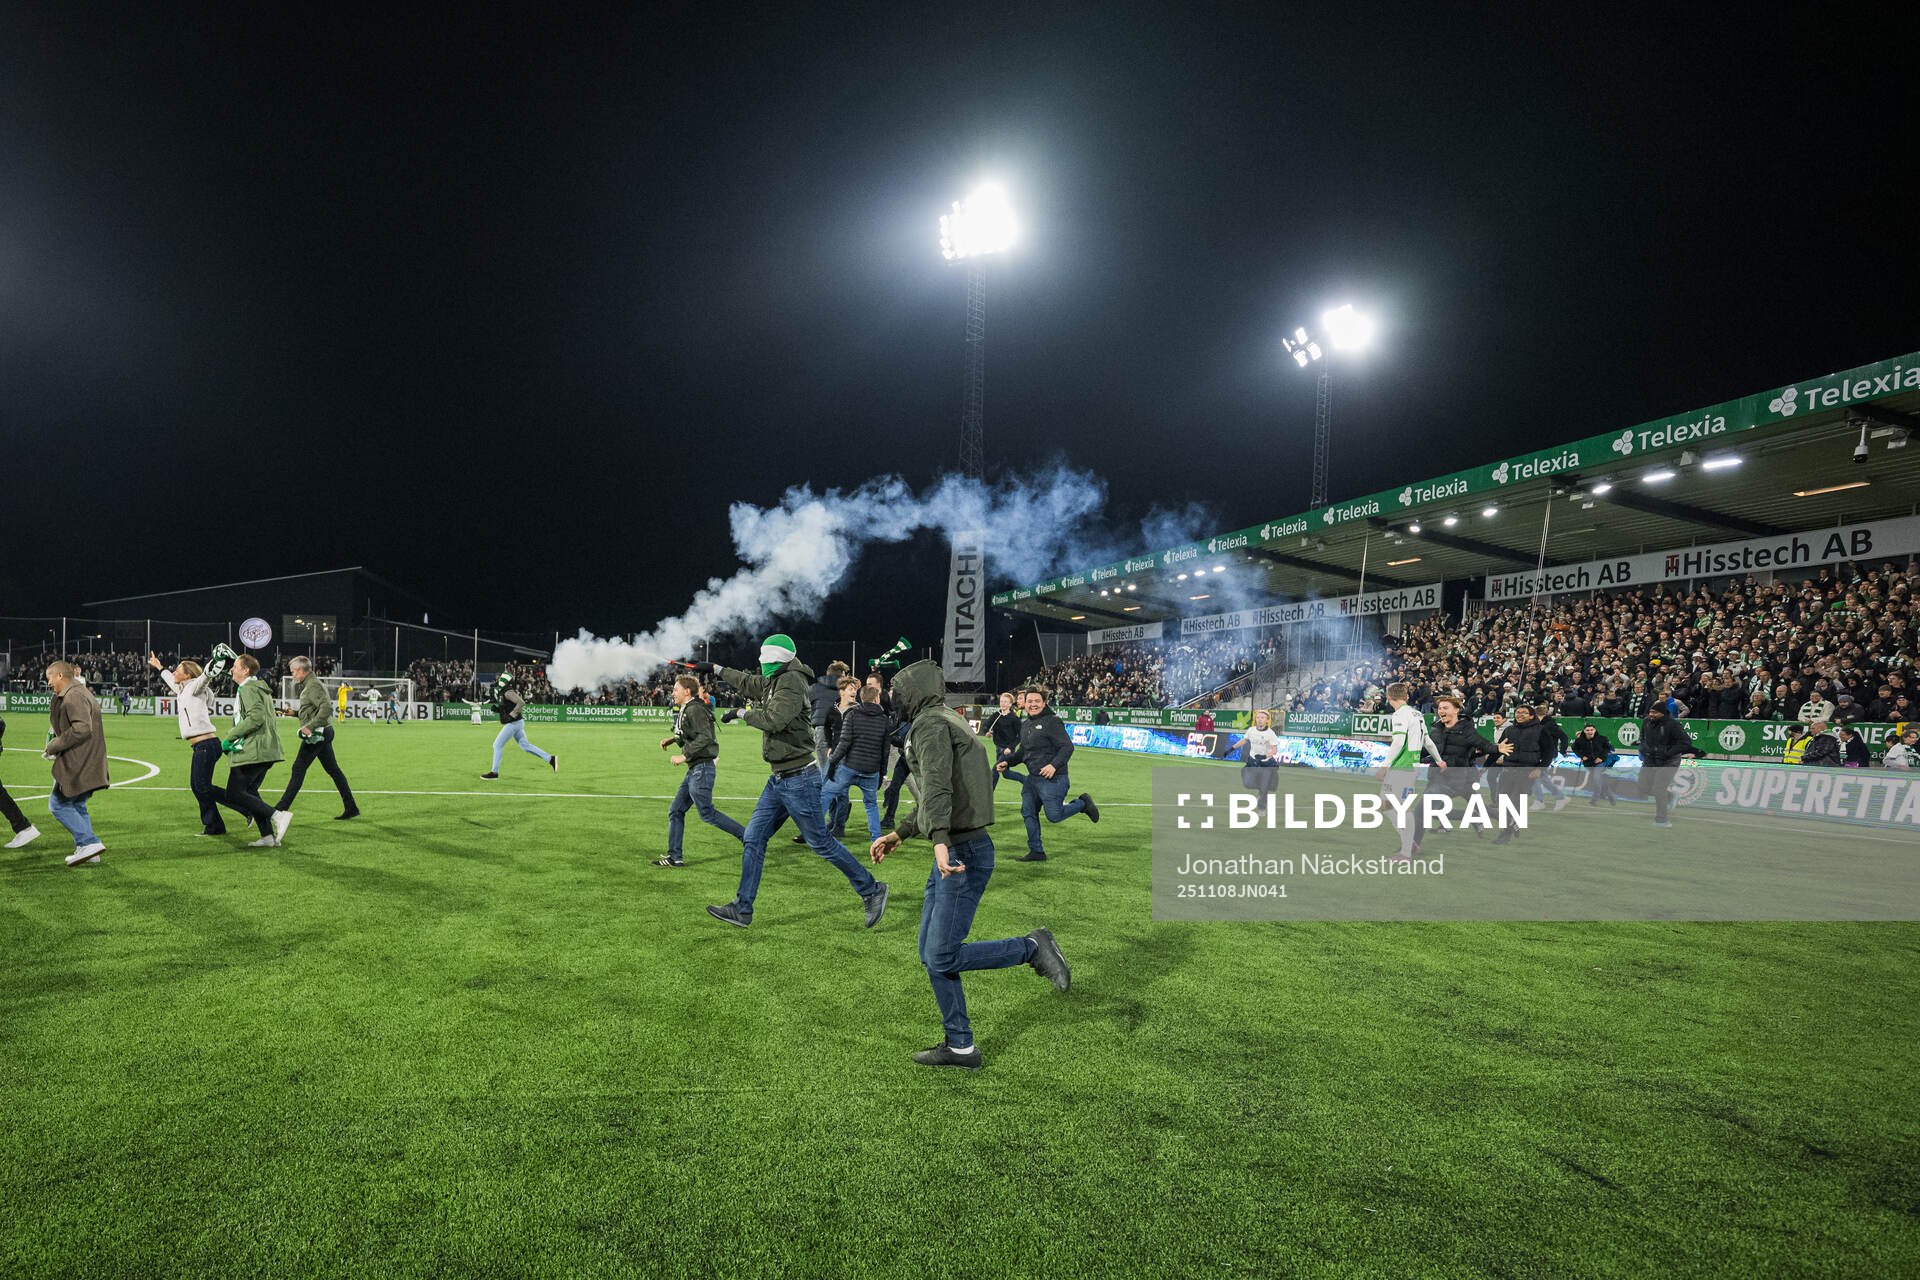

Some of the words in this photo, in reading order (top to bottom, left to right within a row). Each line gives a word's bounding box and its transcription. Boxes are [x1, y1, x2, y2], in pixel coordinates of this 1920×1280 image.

[1638, 415, 1726, 450] Telexia
[1512, 450, 1580, 480] Telexia
[1415, 479, 1468, 504] Telexia
[1336, 500, 1380, 523] Telexia
[1271, 519, 1308, 539] Telexia
[1217, 534, 1248, 551] Telexia
[1683, 537, 1810, 576] Hisstech
[1822, 529, 1873, 560] AB
[1170, 547, 1197, 563] Telexia
[1131, 558, 1154, 573] Telexia
[1503, 566, 1589, 597] Hisstech
[1597, 562, 1631, 585] AB
[954, 546, 977, 668] HITACHI
[1349, 592, 1408, 615] Hisstech
[1413, 589, 1435, 607] AB
[1189, 616, 1225, 633] Hisstech
[1227, 615, 1241, 628] AB
[1258, 606, 1304, 625] Hisstech
[1308, 603, 1325, 618] AB
[1134, 627, 1145, 638] AB
[566, 707, 622, 716] SALBOHEDS
[633, 708, 657, 717] SKYLT
[1187, 732, 1203, 744] pre
[1185, 744, 1207, 756] zero
